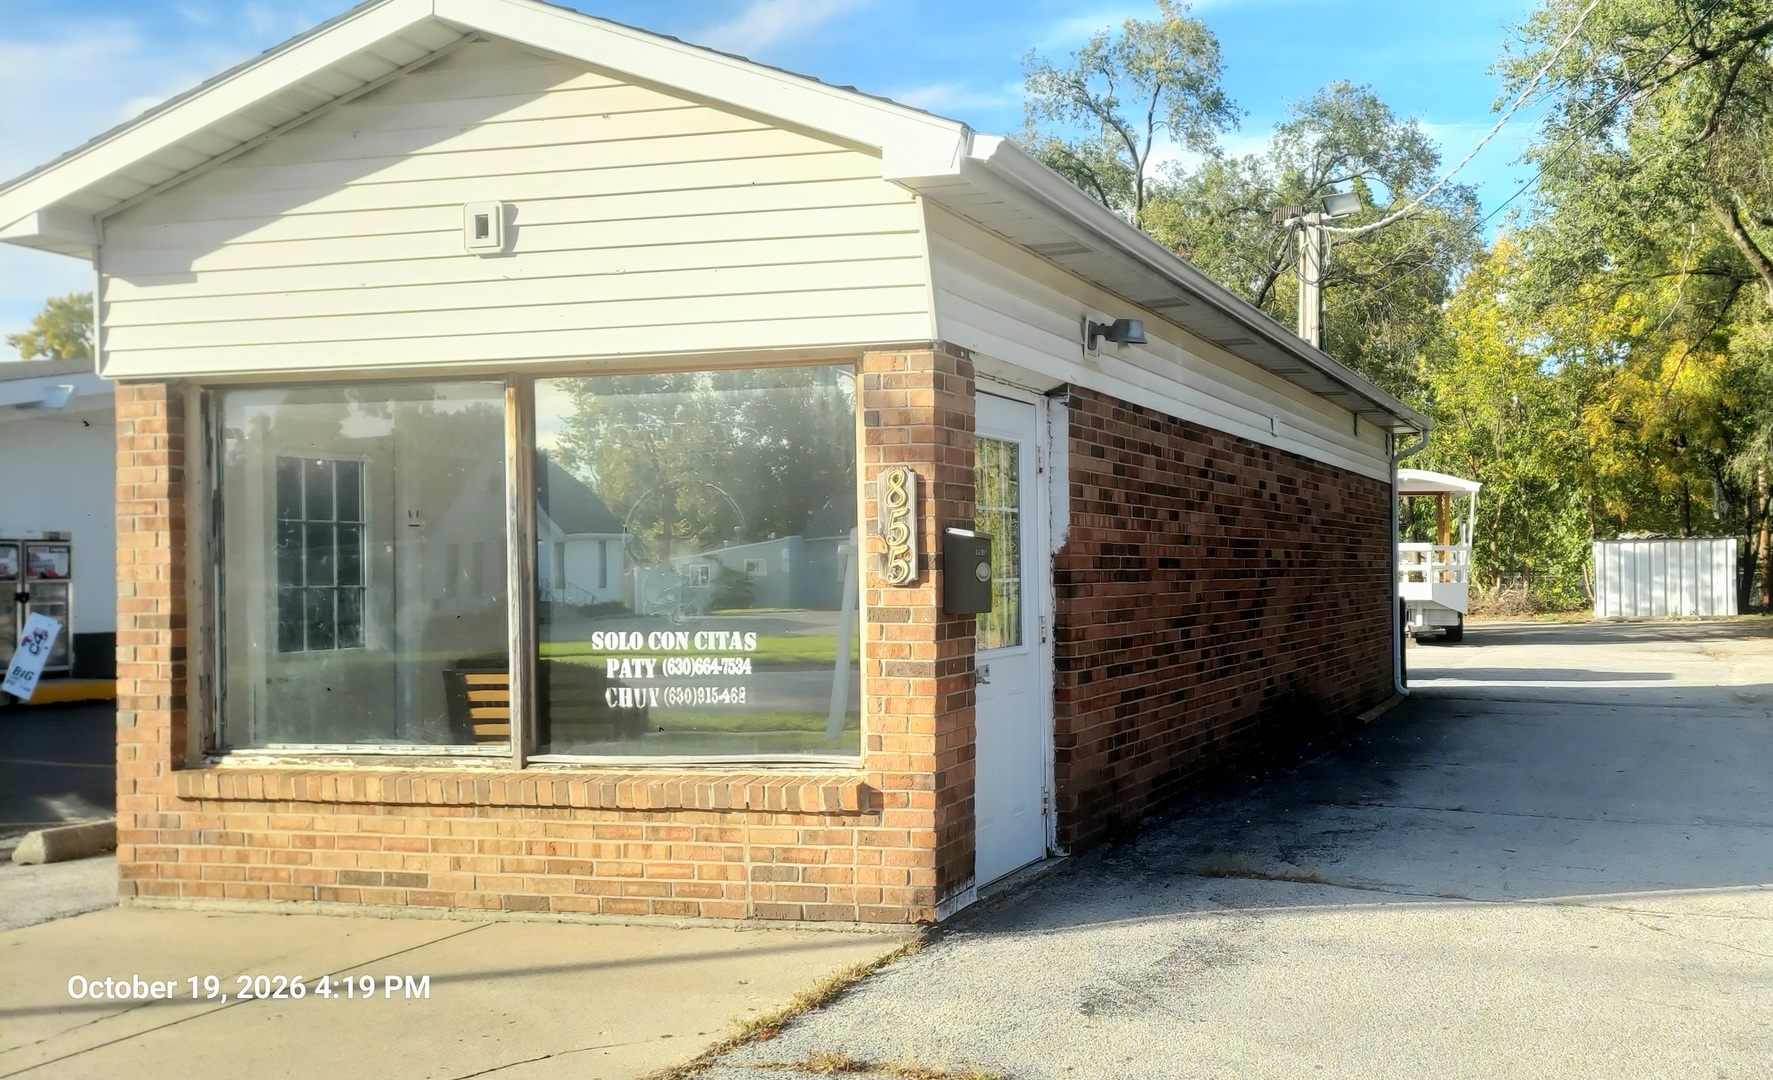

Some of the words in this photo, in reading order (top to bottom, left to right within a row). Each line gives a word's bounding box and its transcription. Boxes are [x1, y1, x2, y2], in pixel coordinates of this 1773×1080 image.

[885, 469, 911, 584] 855
[591, 631, 644, 651] SOLO
[647, 631, 690, 651] CON
[693, 631, 758, 652] CITAS
[12, 665, 35, 682] BIG
[606, 657, 658, 679] PATY
[661, 656, 753, 678] (630)664-7534
[604, 687, 660, 708] CHUY
